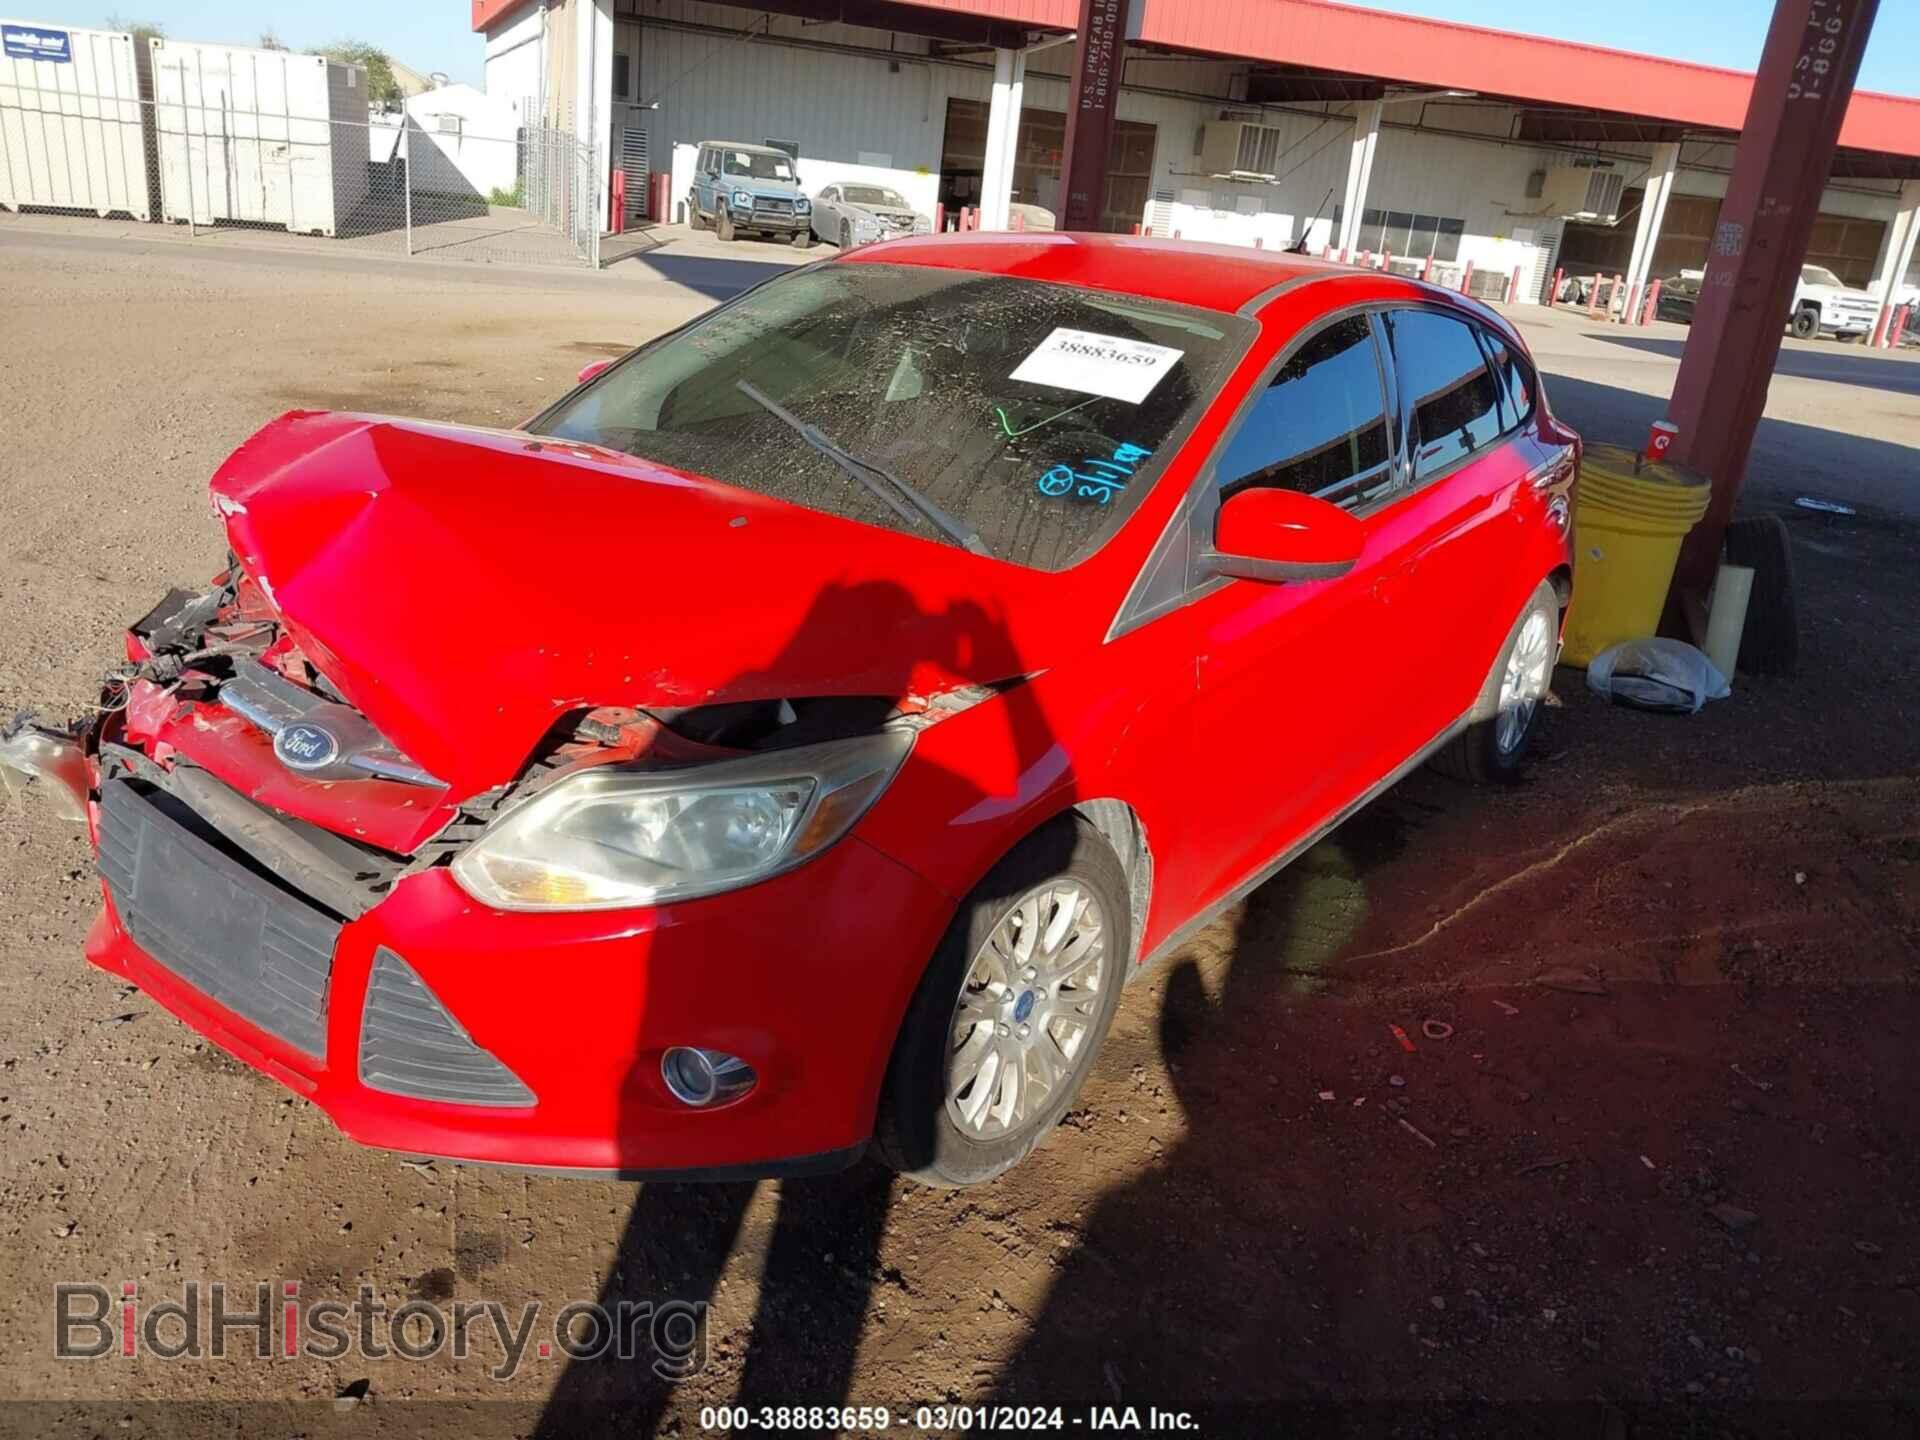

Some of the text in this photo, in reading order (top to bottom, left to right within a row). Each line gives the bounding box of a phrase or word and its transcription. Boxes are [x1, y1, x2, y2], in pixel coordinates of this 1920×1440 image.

[1088, 16, 1104, 73] PREFAB
[1095, 0, 1118, 108] 1-866-799-09
[1082, 83, 1095, 108] U.S.
[1052, 341, 1156, 365] 38883659
[285, 729, 321, 757] Ford
